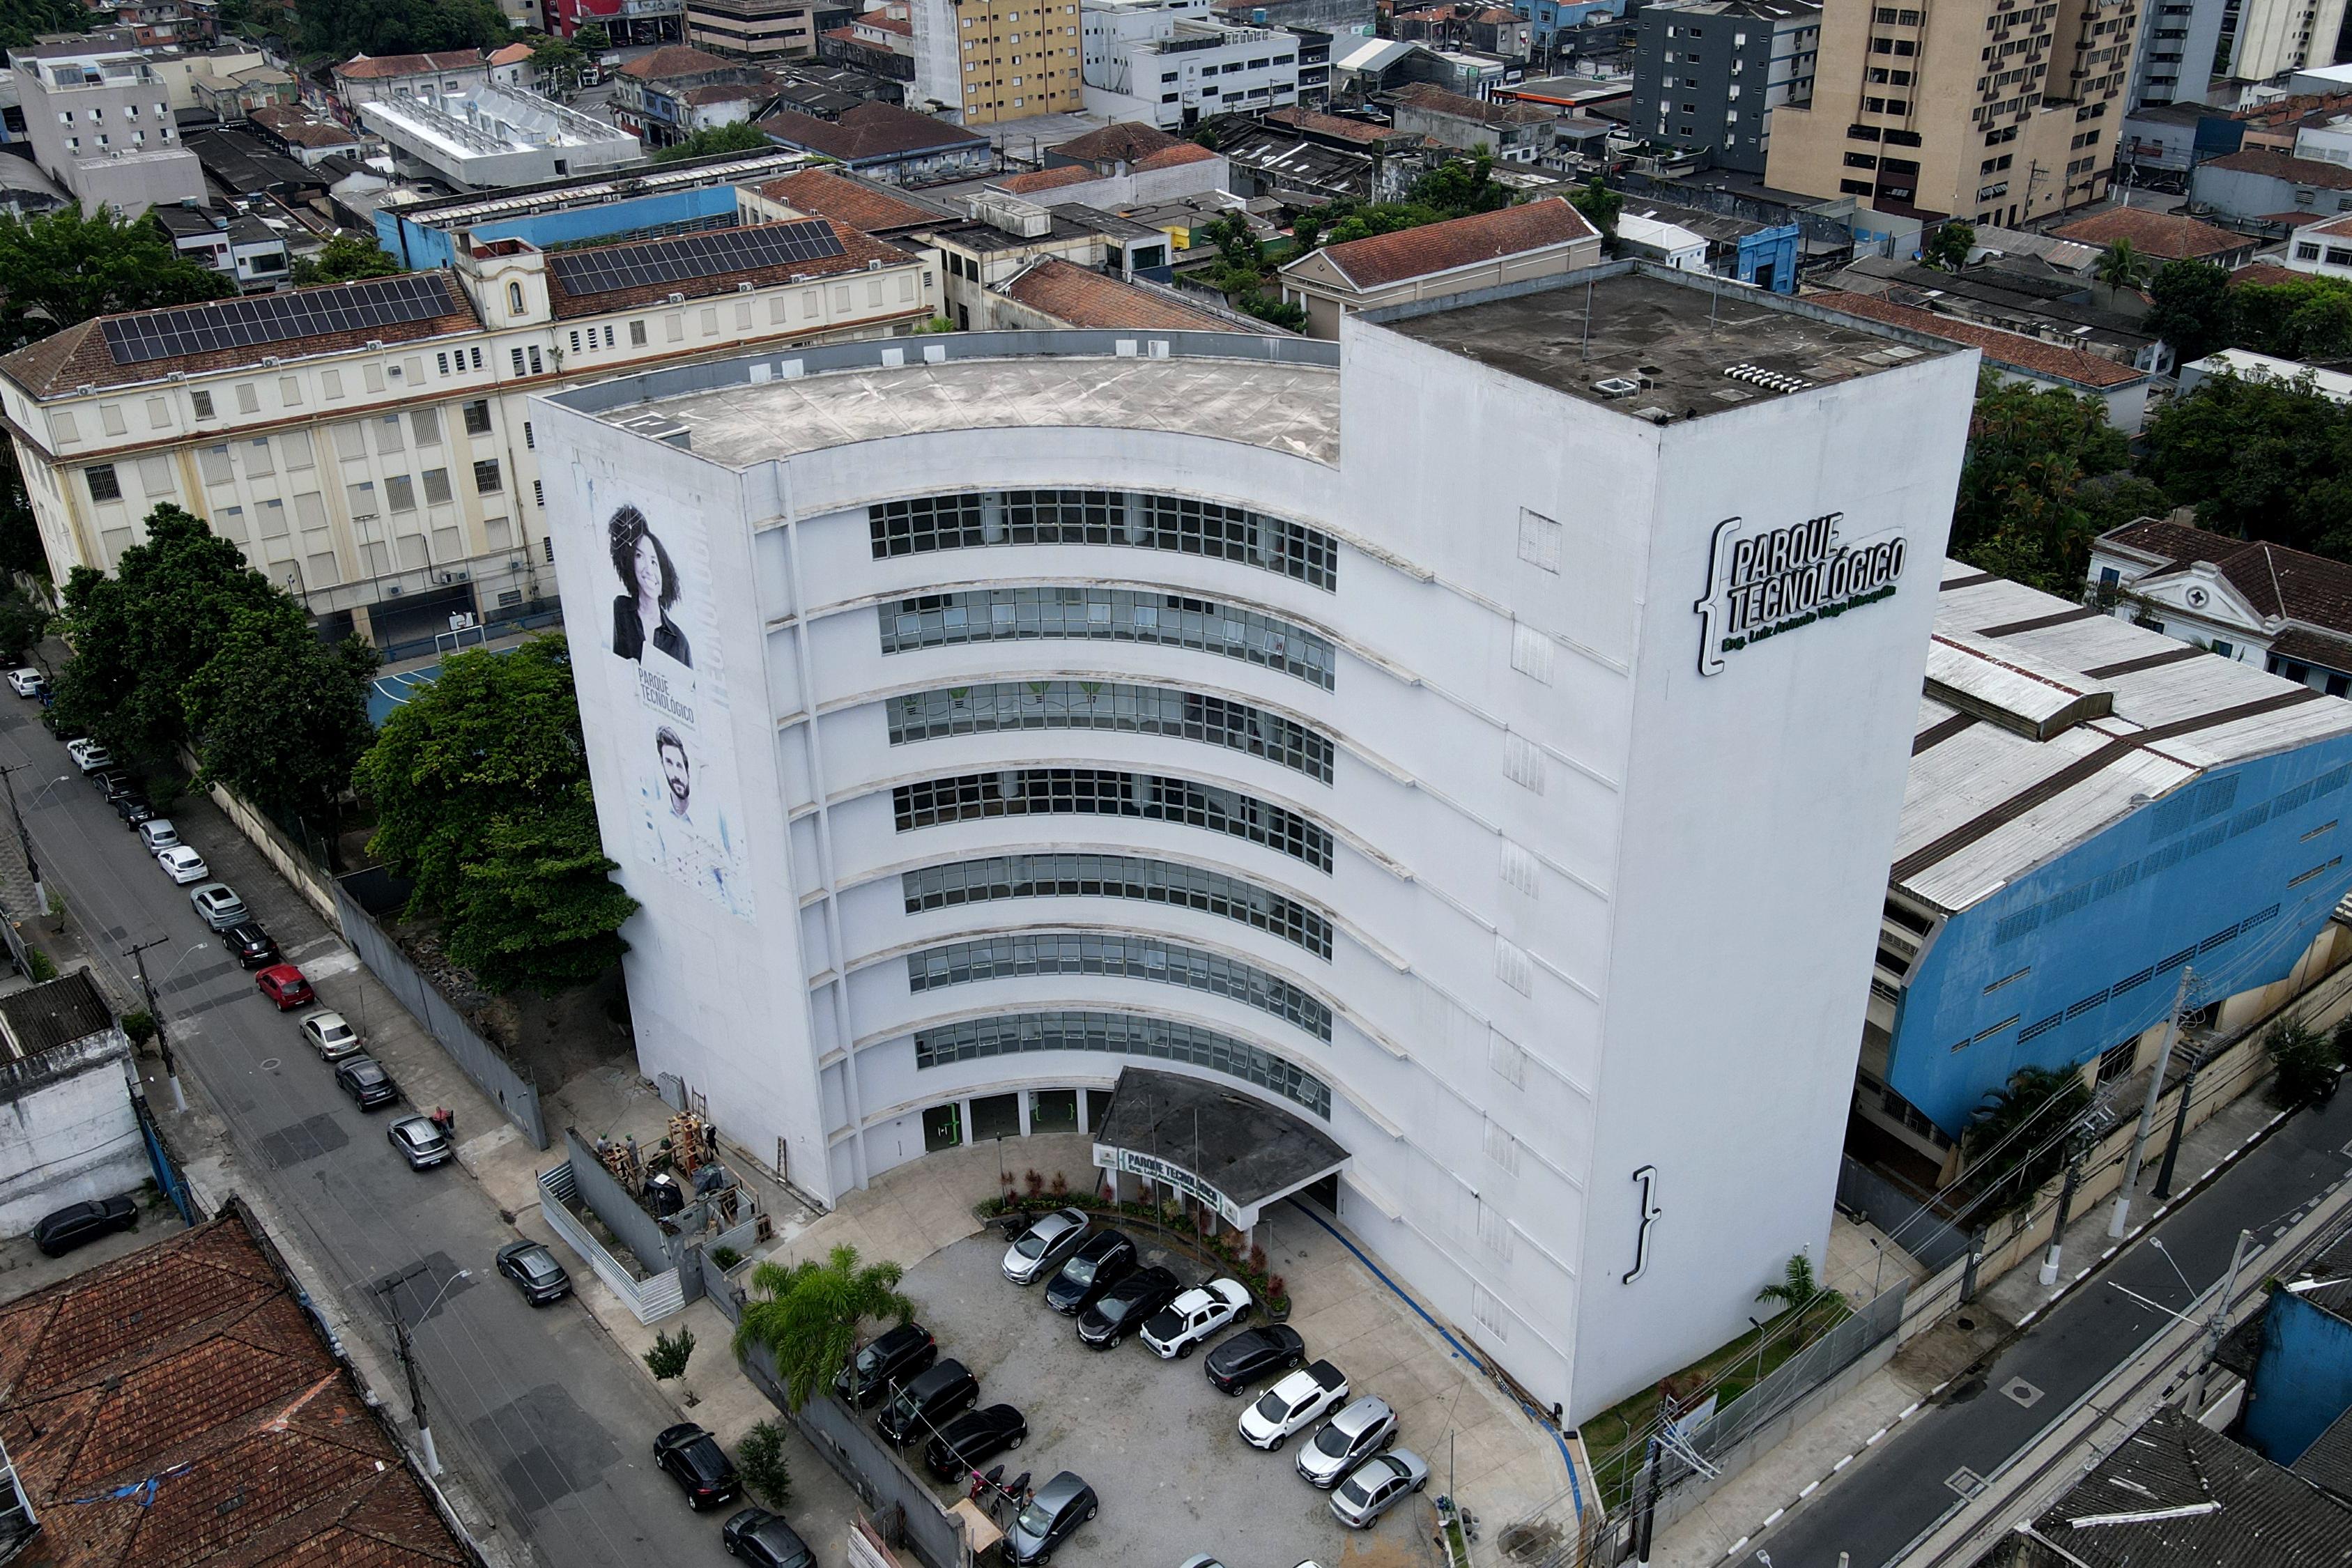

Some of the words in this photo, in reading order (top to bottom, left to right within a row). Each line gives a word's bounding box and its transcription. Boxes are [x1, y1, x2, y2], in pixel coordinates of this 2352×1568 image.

[1730, 512, 1844, 587] PARQUE
[1727, 537, 1907, 633] TECNOLÓGICO
[638, 667, 670, 696] PARQUE
[640, 683, 695, 723] TECNOLÓGICO
